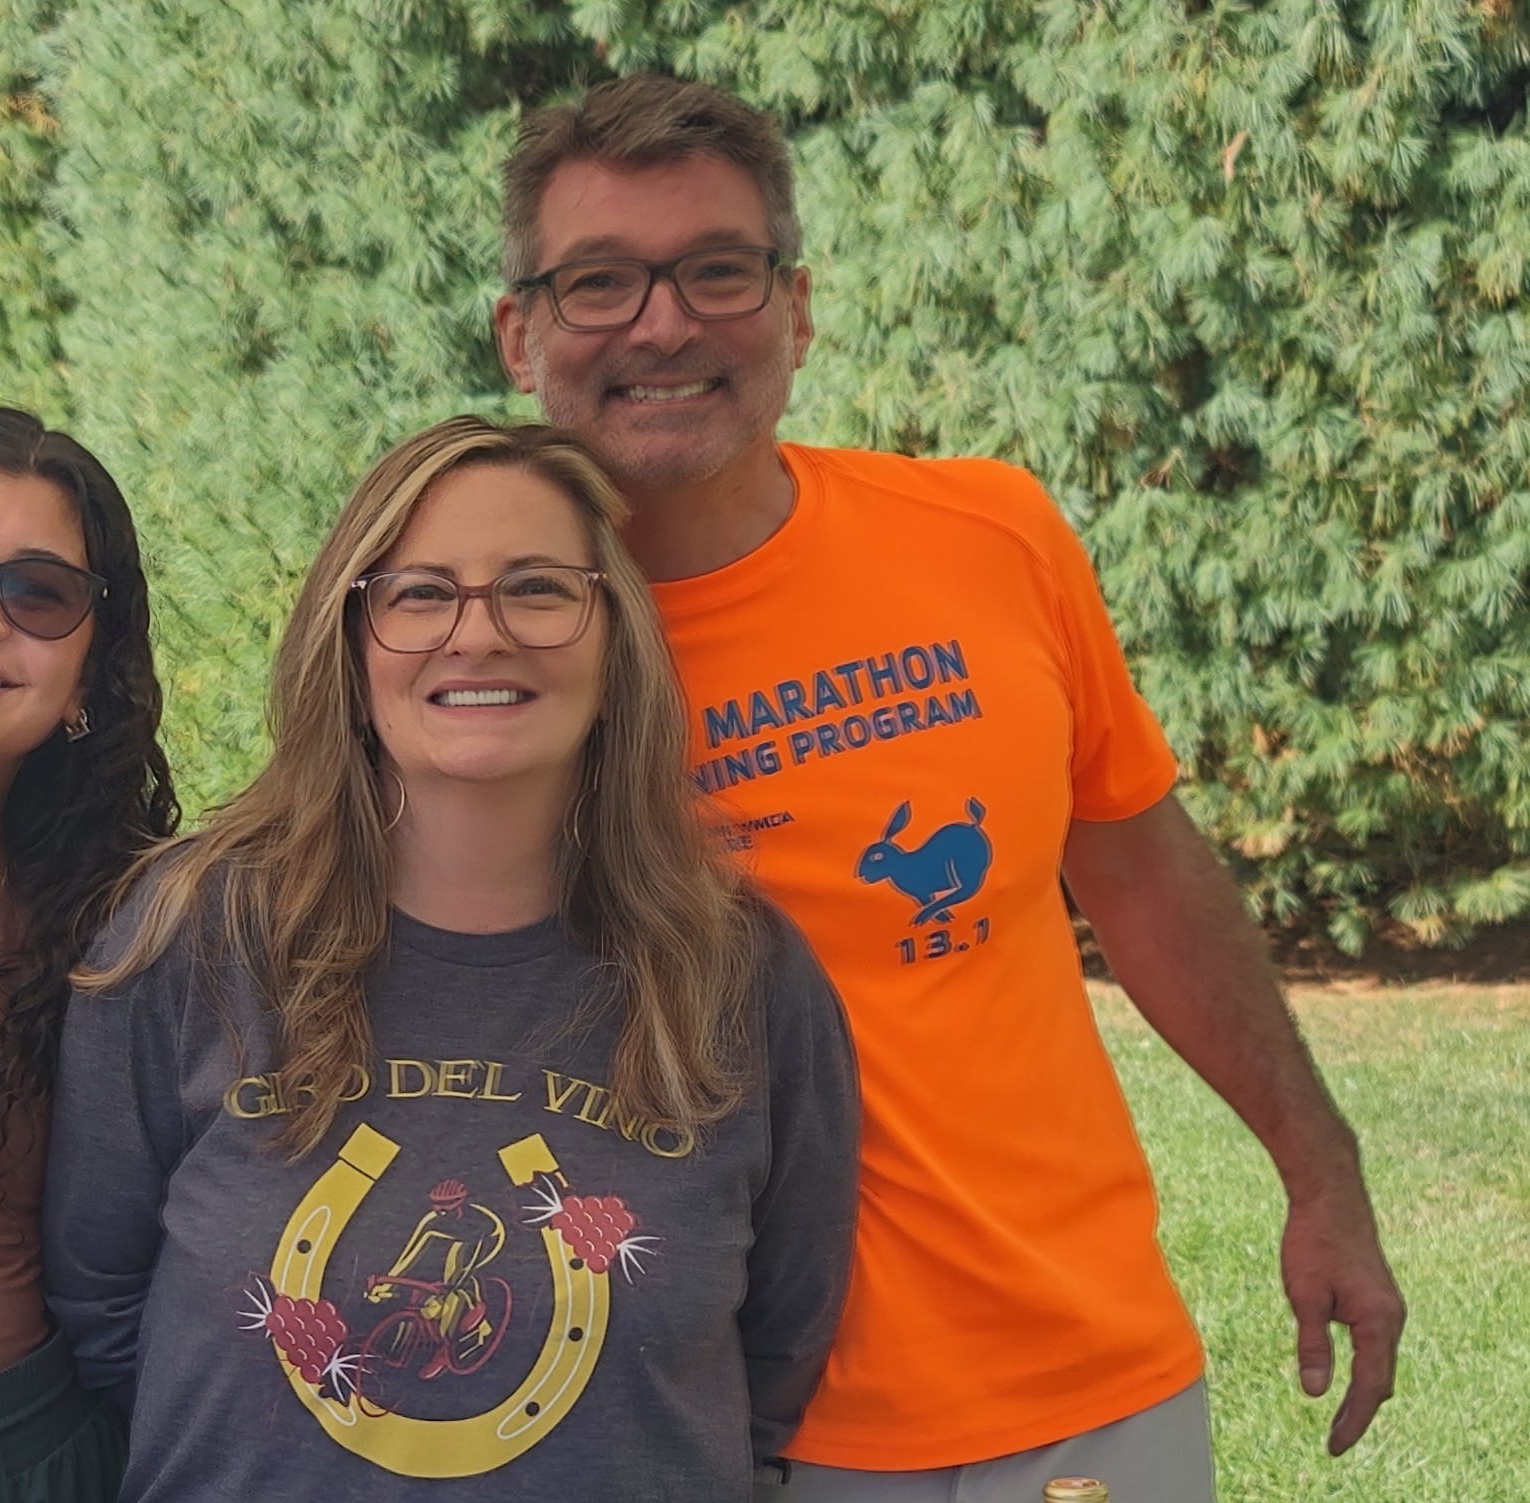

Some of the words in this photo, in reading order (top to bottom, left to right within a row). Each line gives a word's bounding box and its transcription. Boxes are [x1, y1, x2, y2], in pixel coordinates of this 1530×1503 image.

[701, 639, 969, 749] MARATHON
[787, 688, 983, 765] PROGRAM
[895, 917, 990, 966] 13.1
[384, 1058, 523, 1100] DEL
